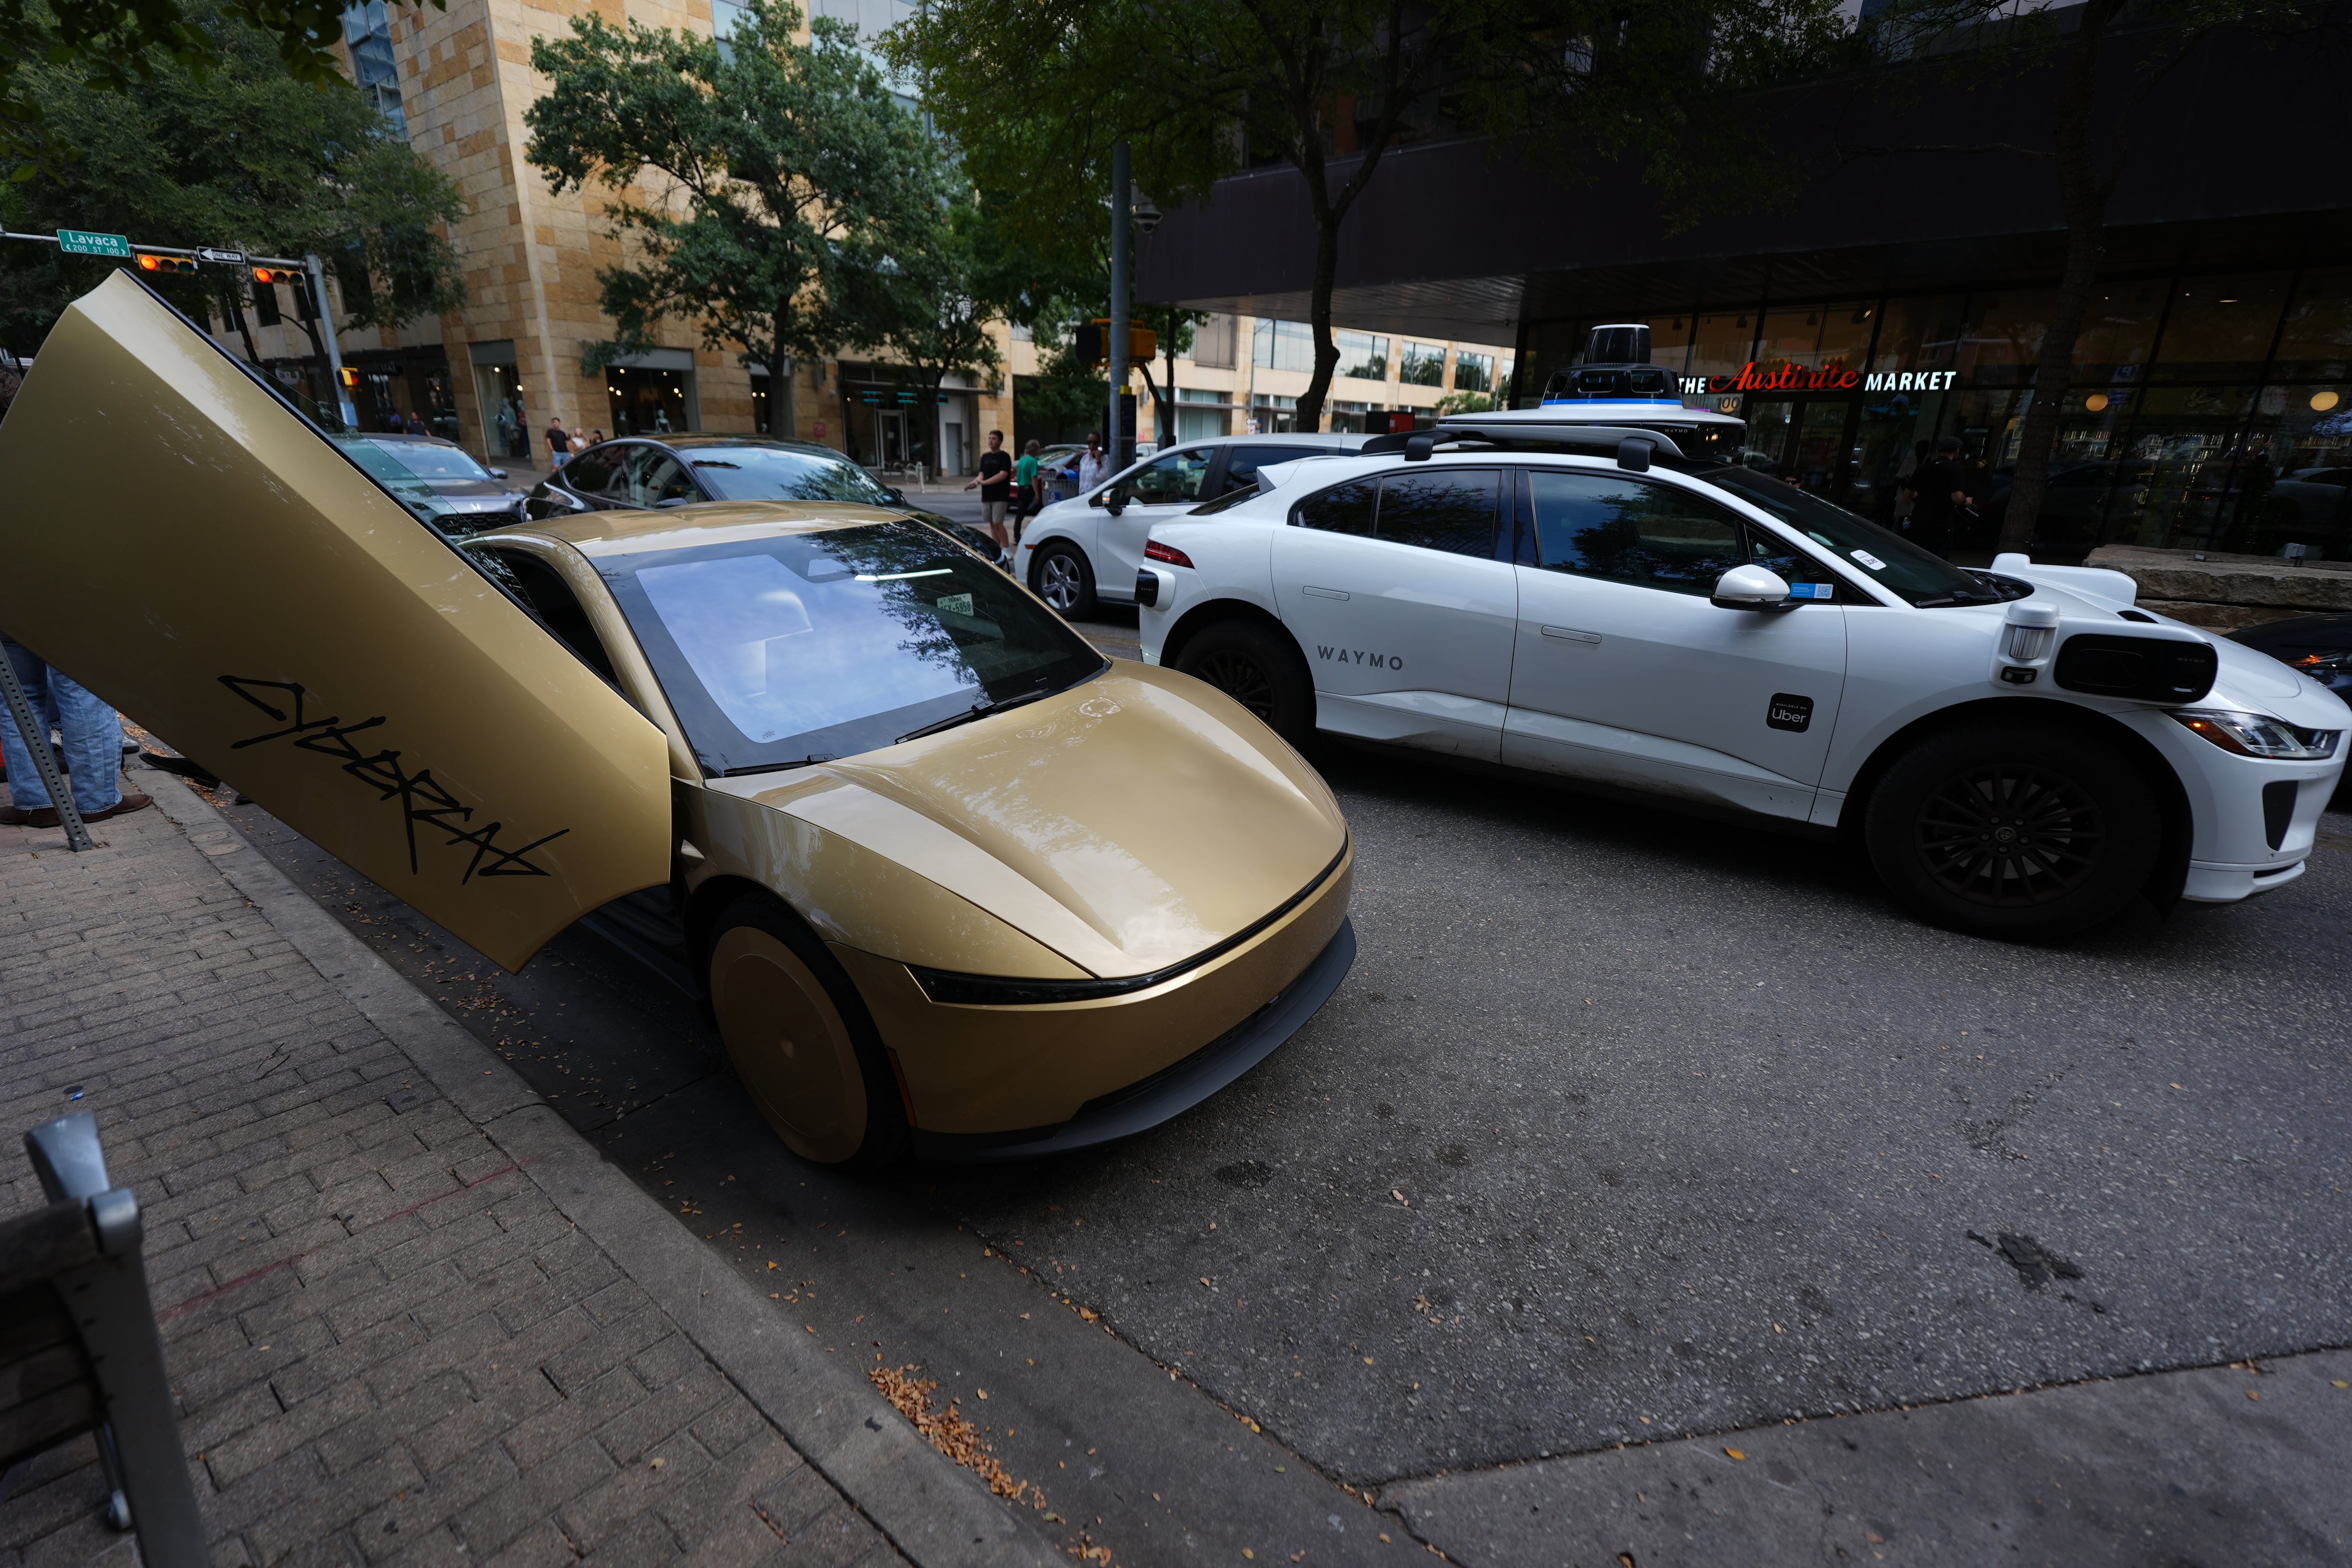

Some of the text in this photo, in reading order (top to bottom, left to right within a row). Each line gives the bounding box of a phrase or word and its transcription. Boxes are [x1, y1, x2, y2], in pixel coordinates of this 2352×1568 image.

[68, 232, 118, 247] Lavaca
[1708, 361, 1861, 393] Austinite
[1865, 371, 1957, 392] MARKET
[1716, 397, 1740, 409] 100
[1318, 645, 1403, 670] WAYMO
[1772, 708, 1806, 723] Uber
